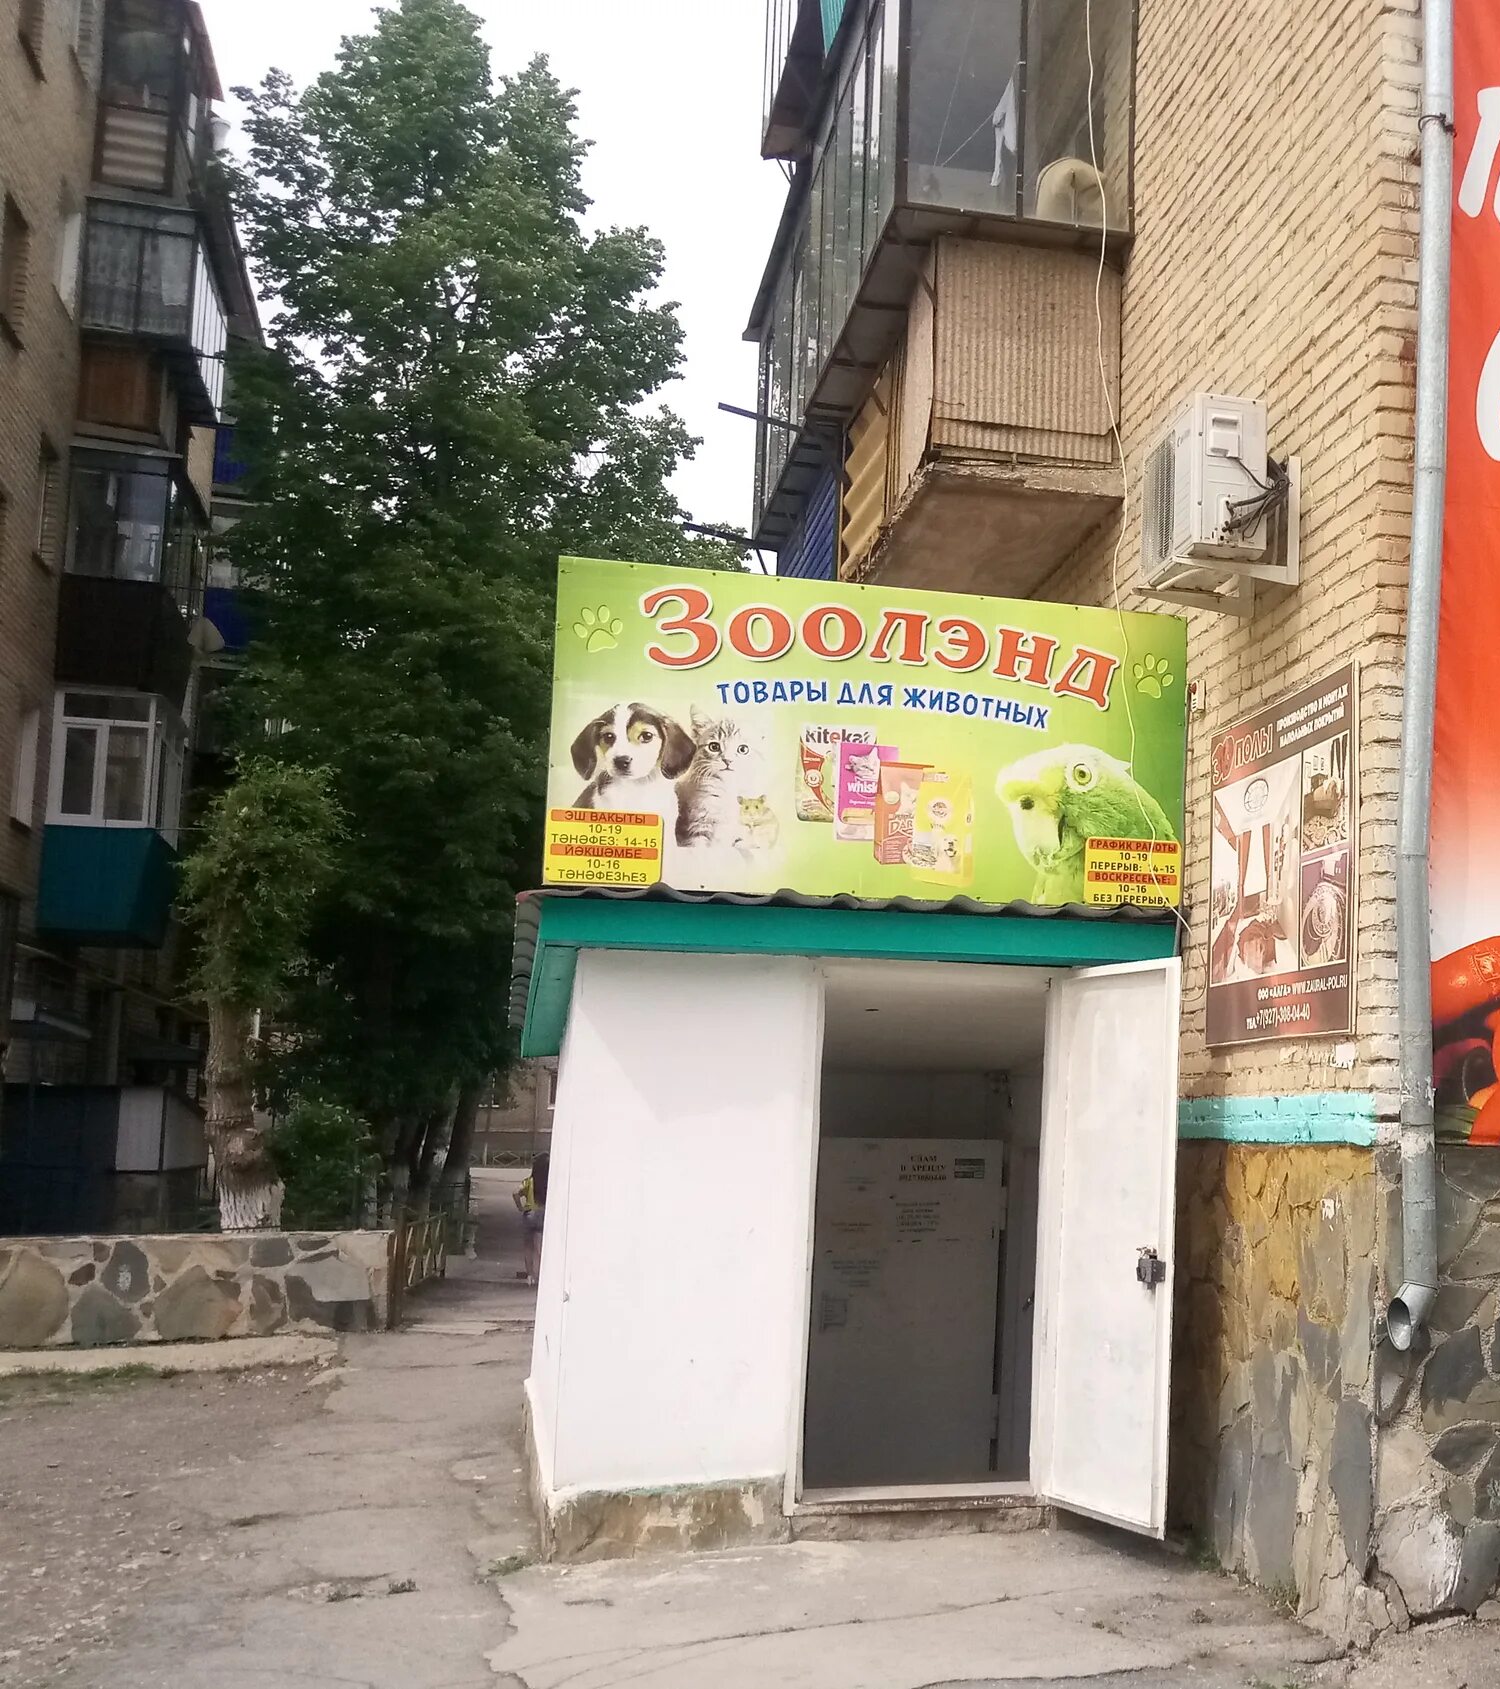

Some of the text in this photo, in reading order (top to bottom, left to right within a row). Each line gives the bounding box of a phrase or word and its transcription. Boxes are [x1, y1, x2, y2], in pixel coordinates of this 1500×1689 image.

[716, 680, 1049, 729] ТОВАРЫ ДЛЯ ЖИВОТНЫХ
[1234, 723, 1273, 769] ПОЛЫ
[564, 810, 586, 821] ЭШ
[588, 824, 622, 834] 10-19
[624, 838, 657, 848] 14-15
[1090, 840, 1135, 850] ГРАФИК
[1119, 852, 1148, 861] 10-19
[586, 859, 620, 870] 10-16
[1090, 861, 1142, 872] ПЕРЕРЫВ:
[1118, 884, 1147, 894] 10-16
[1093, 894, 1170, 905] БЕЗ ПЕРЕРЫВА
